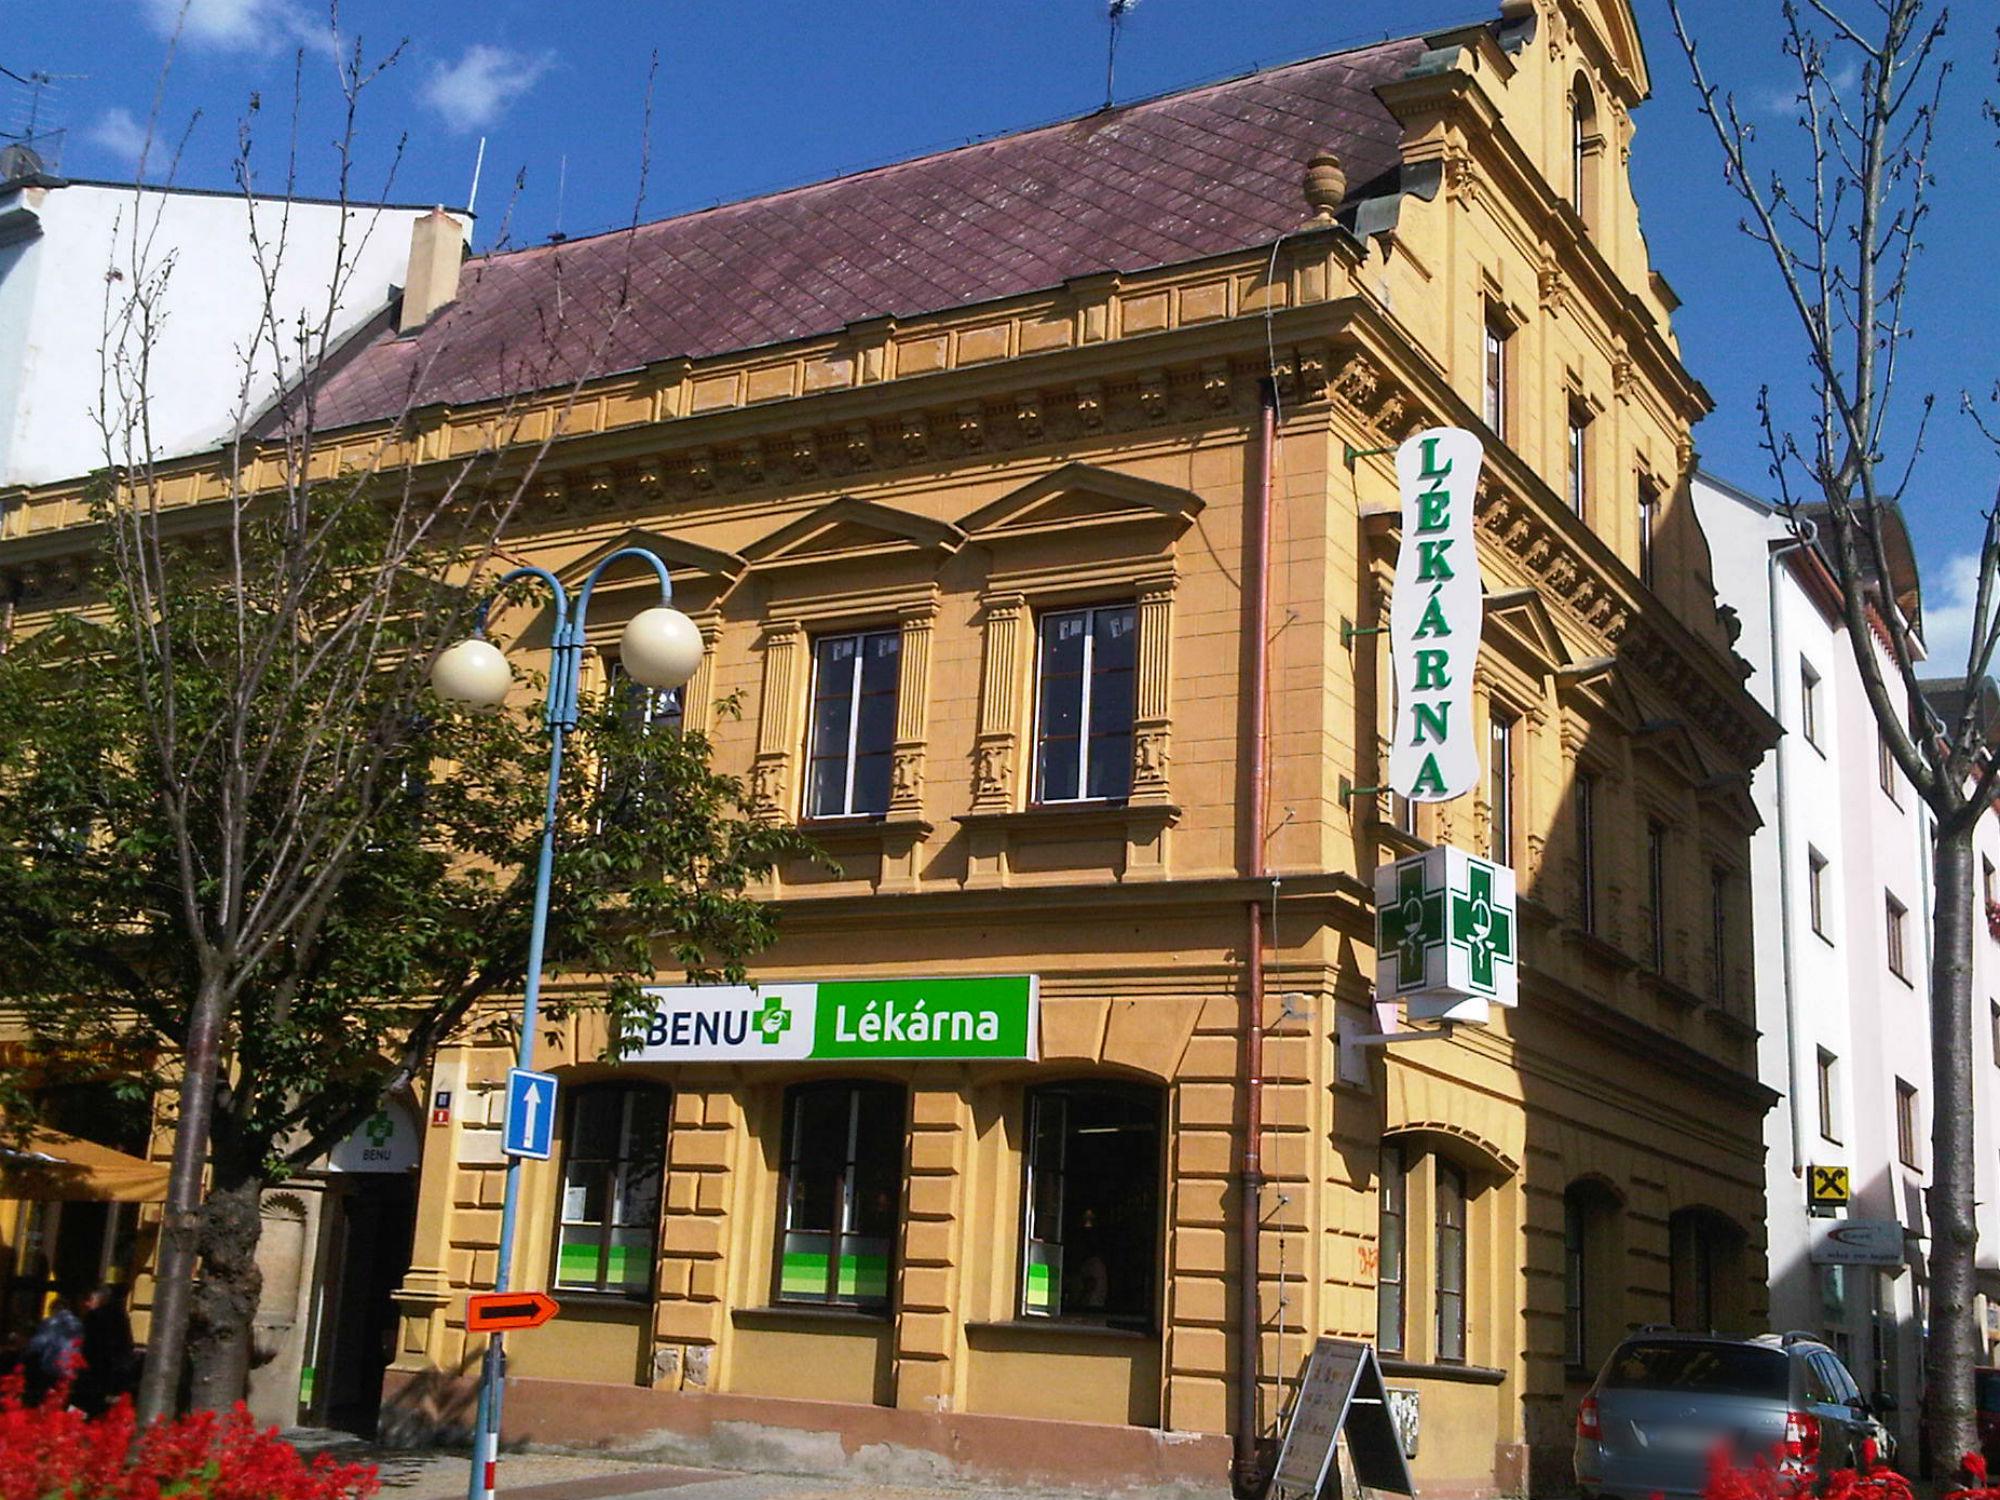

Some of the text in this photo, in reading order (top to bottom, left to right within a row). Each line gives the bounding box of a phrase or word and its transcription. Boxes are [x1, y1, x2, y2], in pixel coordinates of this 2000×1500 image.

[1411, 437, 1455, 798] LÉKÁRNA
[646, 999, 999, 1046] BENU Lékárna
[363, 1149, 391, 1160] BENU
